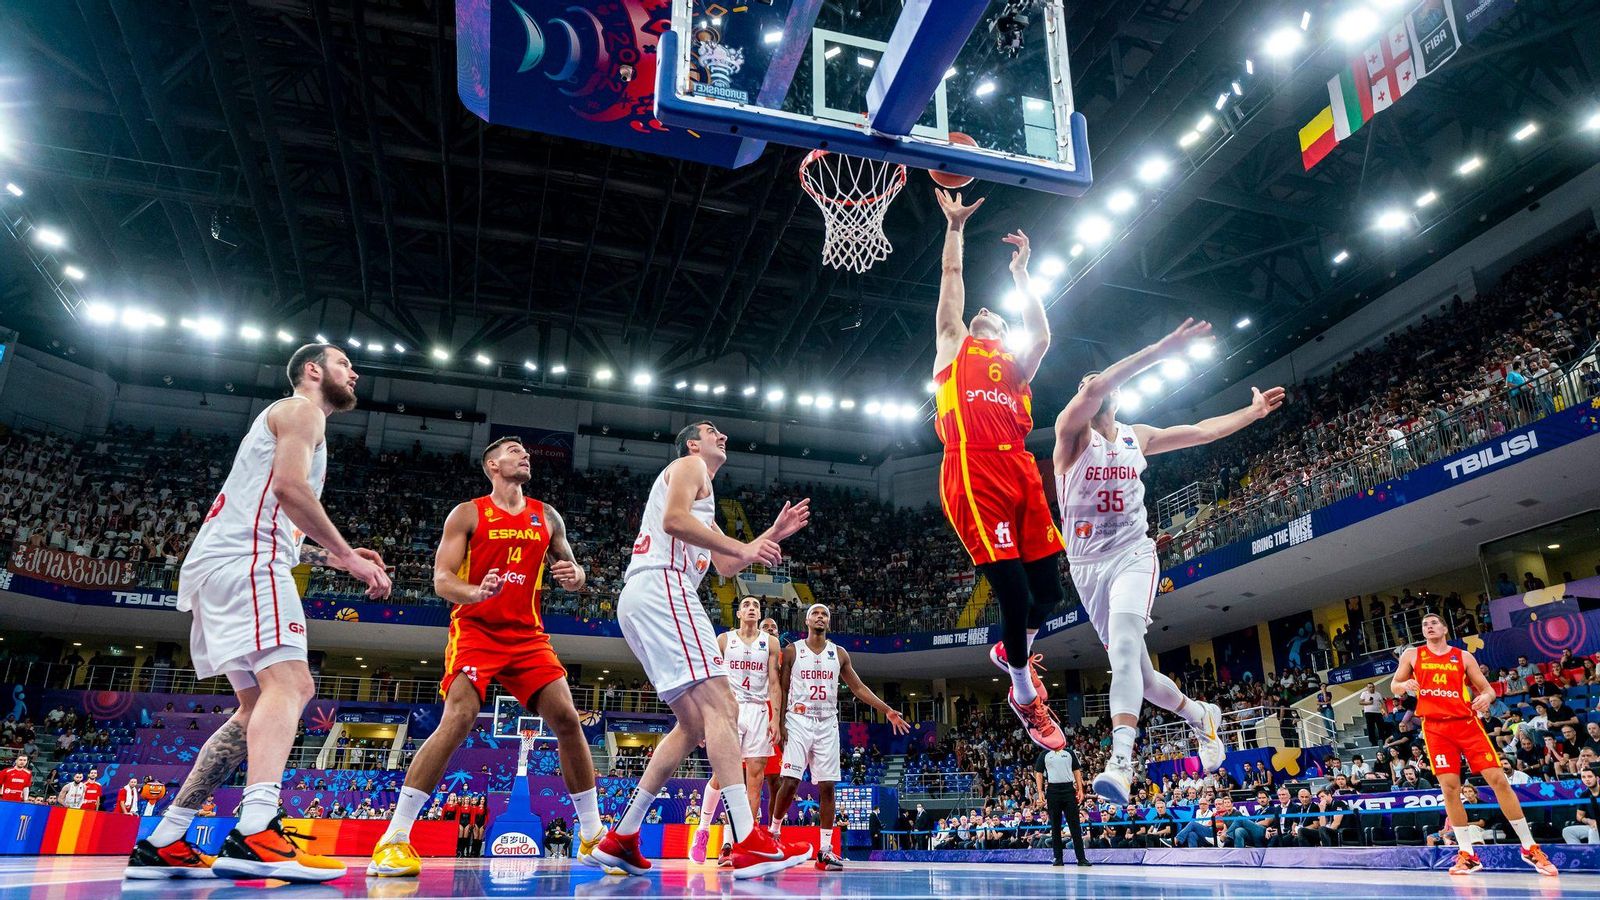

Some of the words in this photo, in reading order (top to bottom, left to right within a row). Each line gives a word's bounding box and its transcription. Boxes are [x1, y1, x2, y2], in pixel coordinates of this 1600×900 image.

[1424, 29, 1447, 54] FIBA
[988, 362, 1002, 382] 6
[1443, 430, 1539, 480] TBILISI
[1085, 466, 1138, 480] GEORGIA
[1097, 490, 1124, 513] 35
[488, 529, 541, 542] ESPAÑA
[1252, 534, 1274, 555] BRING
[1273, 528, 1289, 546] THE
[1288, 513, 1313, 546] NOISE
[506, 546, 522, 564] 14
[112, 591, 178, 606] TBILIS
[1045, 610, 1078, 632] TBILISI
[933, 633, 953, 645] BRING
[954, 632, 967, 643] THE
[967, 626, 989, 646] NOISE
[730, 660, 764, 671] GEORGIA
[1421, 662, 1458, 672] ESPAÑA
[800, 670, 834, 680] GEORGIA
[1432, 673, 1447, 685] 44
[741, 676, 751, 690] 4
[809, 685, 827, 700] 25
[1420, 687, 1460, 699] endesa
